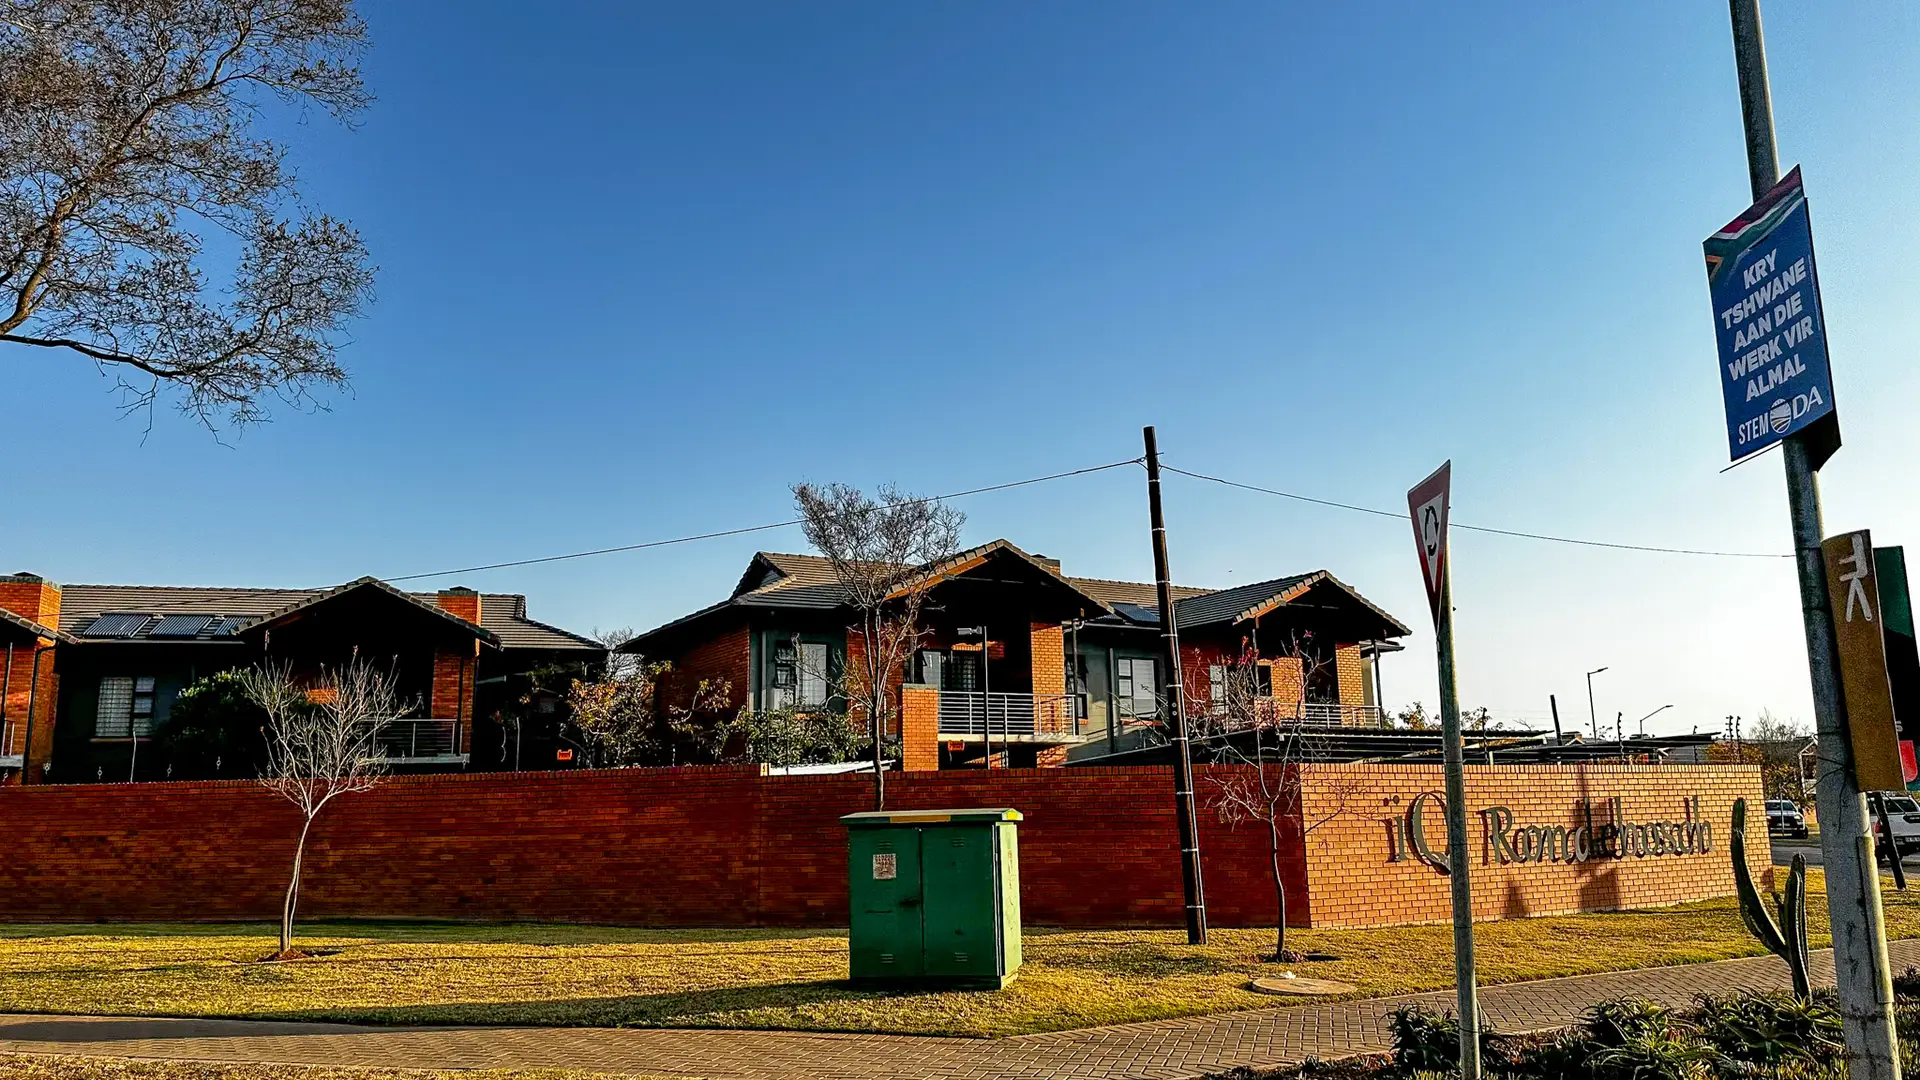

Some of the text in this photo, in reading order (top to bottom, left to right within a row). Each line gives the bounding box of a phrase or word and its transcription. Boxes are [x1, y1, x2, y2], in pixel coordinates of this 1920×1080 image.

[1721, 257, 1806, 330] TSHWANE
[1743, 248, 1777, 289] KRY
[1728, 315, 1814, 381] WERK VIR
[1734, 291, 1803, 352] AAN DIE
[1746, 353, 1806, 402] ALMAL
[1738, 386, 1823, 445] STEM DA
[1485, 795, 1714, 864] Rondebosch
